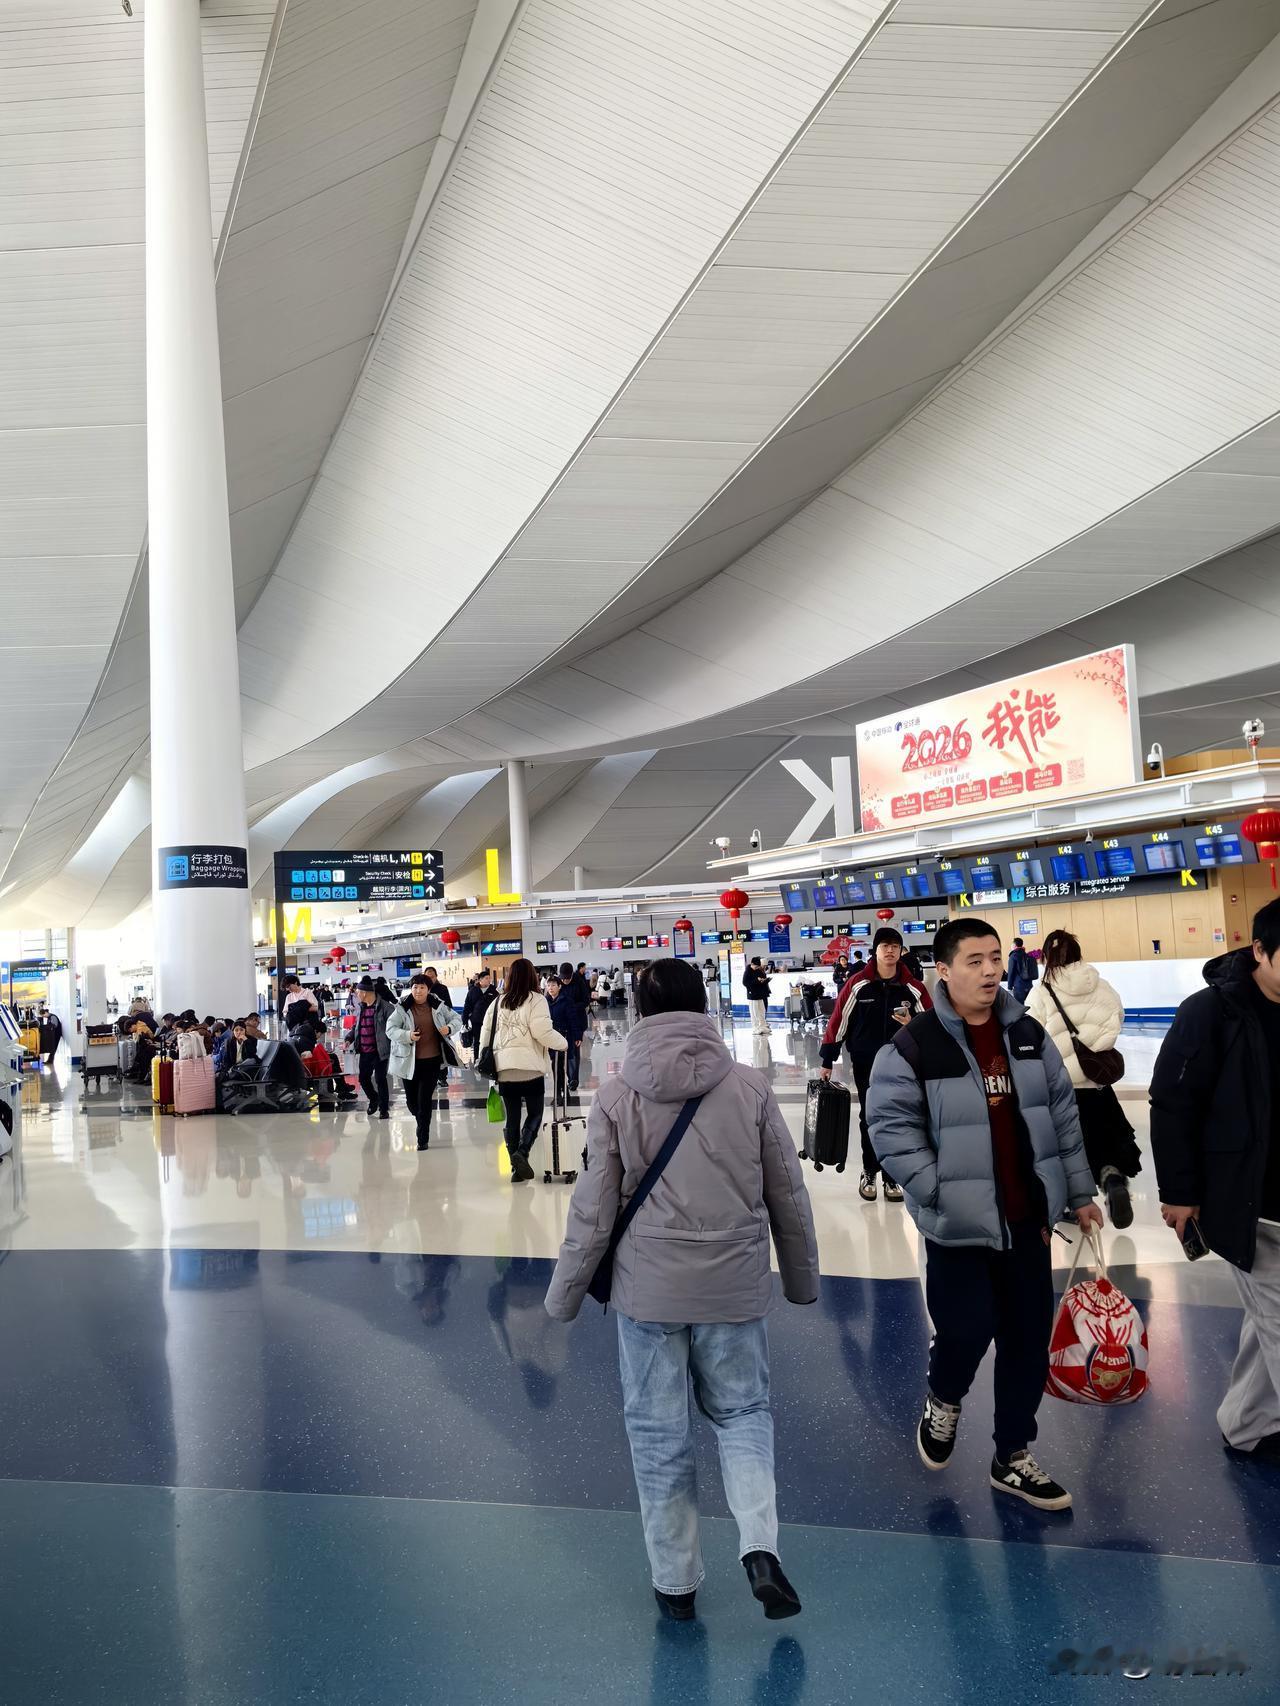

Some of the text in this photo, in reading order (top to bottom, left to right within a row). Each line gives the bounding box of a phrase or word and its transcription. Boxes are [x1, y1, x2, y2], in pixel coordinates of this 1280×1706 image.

[982, 689, 1061, 763] 我能
[901, 718, 972, 772] 2026
[1205, 824, 1223, 835] K45
[1152, 832, 1169, 842] K44
[1103, 839, 1119, 849] K43
[1058, 846, 1072, 855] K42
[191, 854, 233, 864] 行李打包
[400, 854, 411, 863] M
[976, 857, 990, 865] K40
[1016, 852, 1029, 861] K41
[222, 866, 246, 874] Wrapping
[940, 863, 952, 871] K39
[395, 871, 410, 880] 安检
[486, 849, 522, 904] L
[1181, 870, 1198, 887] K
[960, 893, 971, 907] K
[269, 907, 312, 944] M
